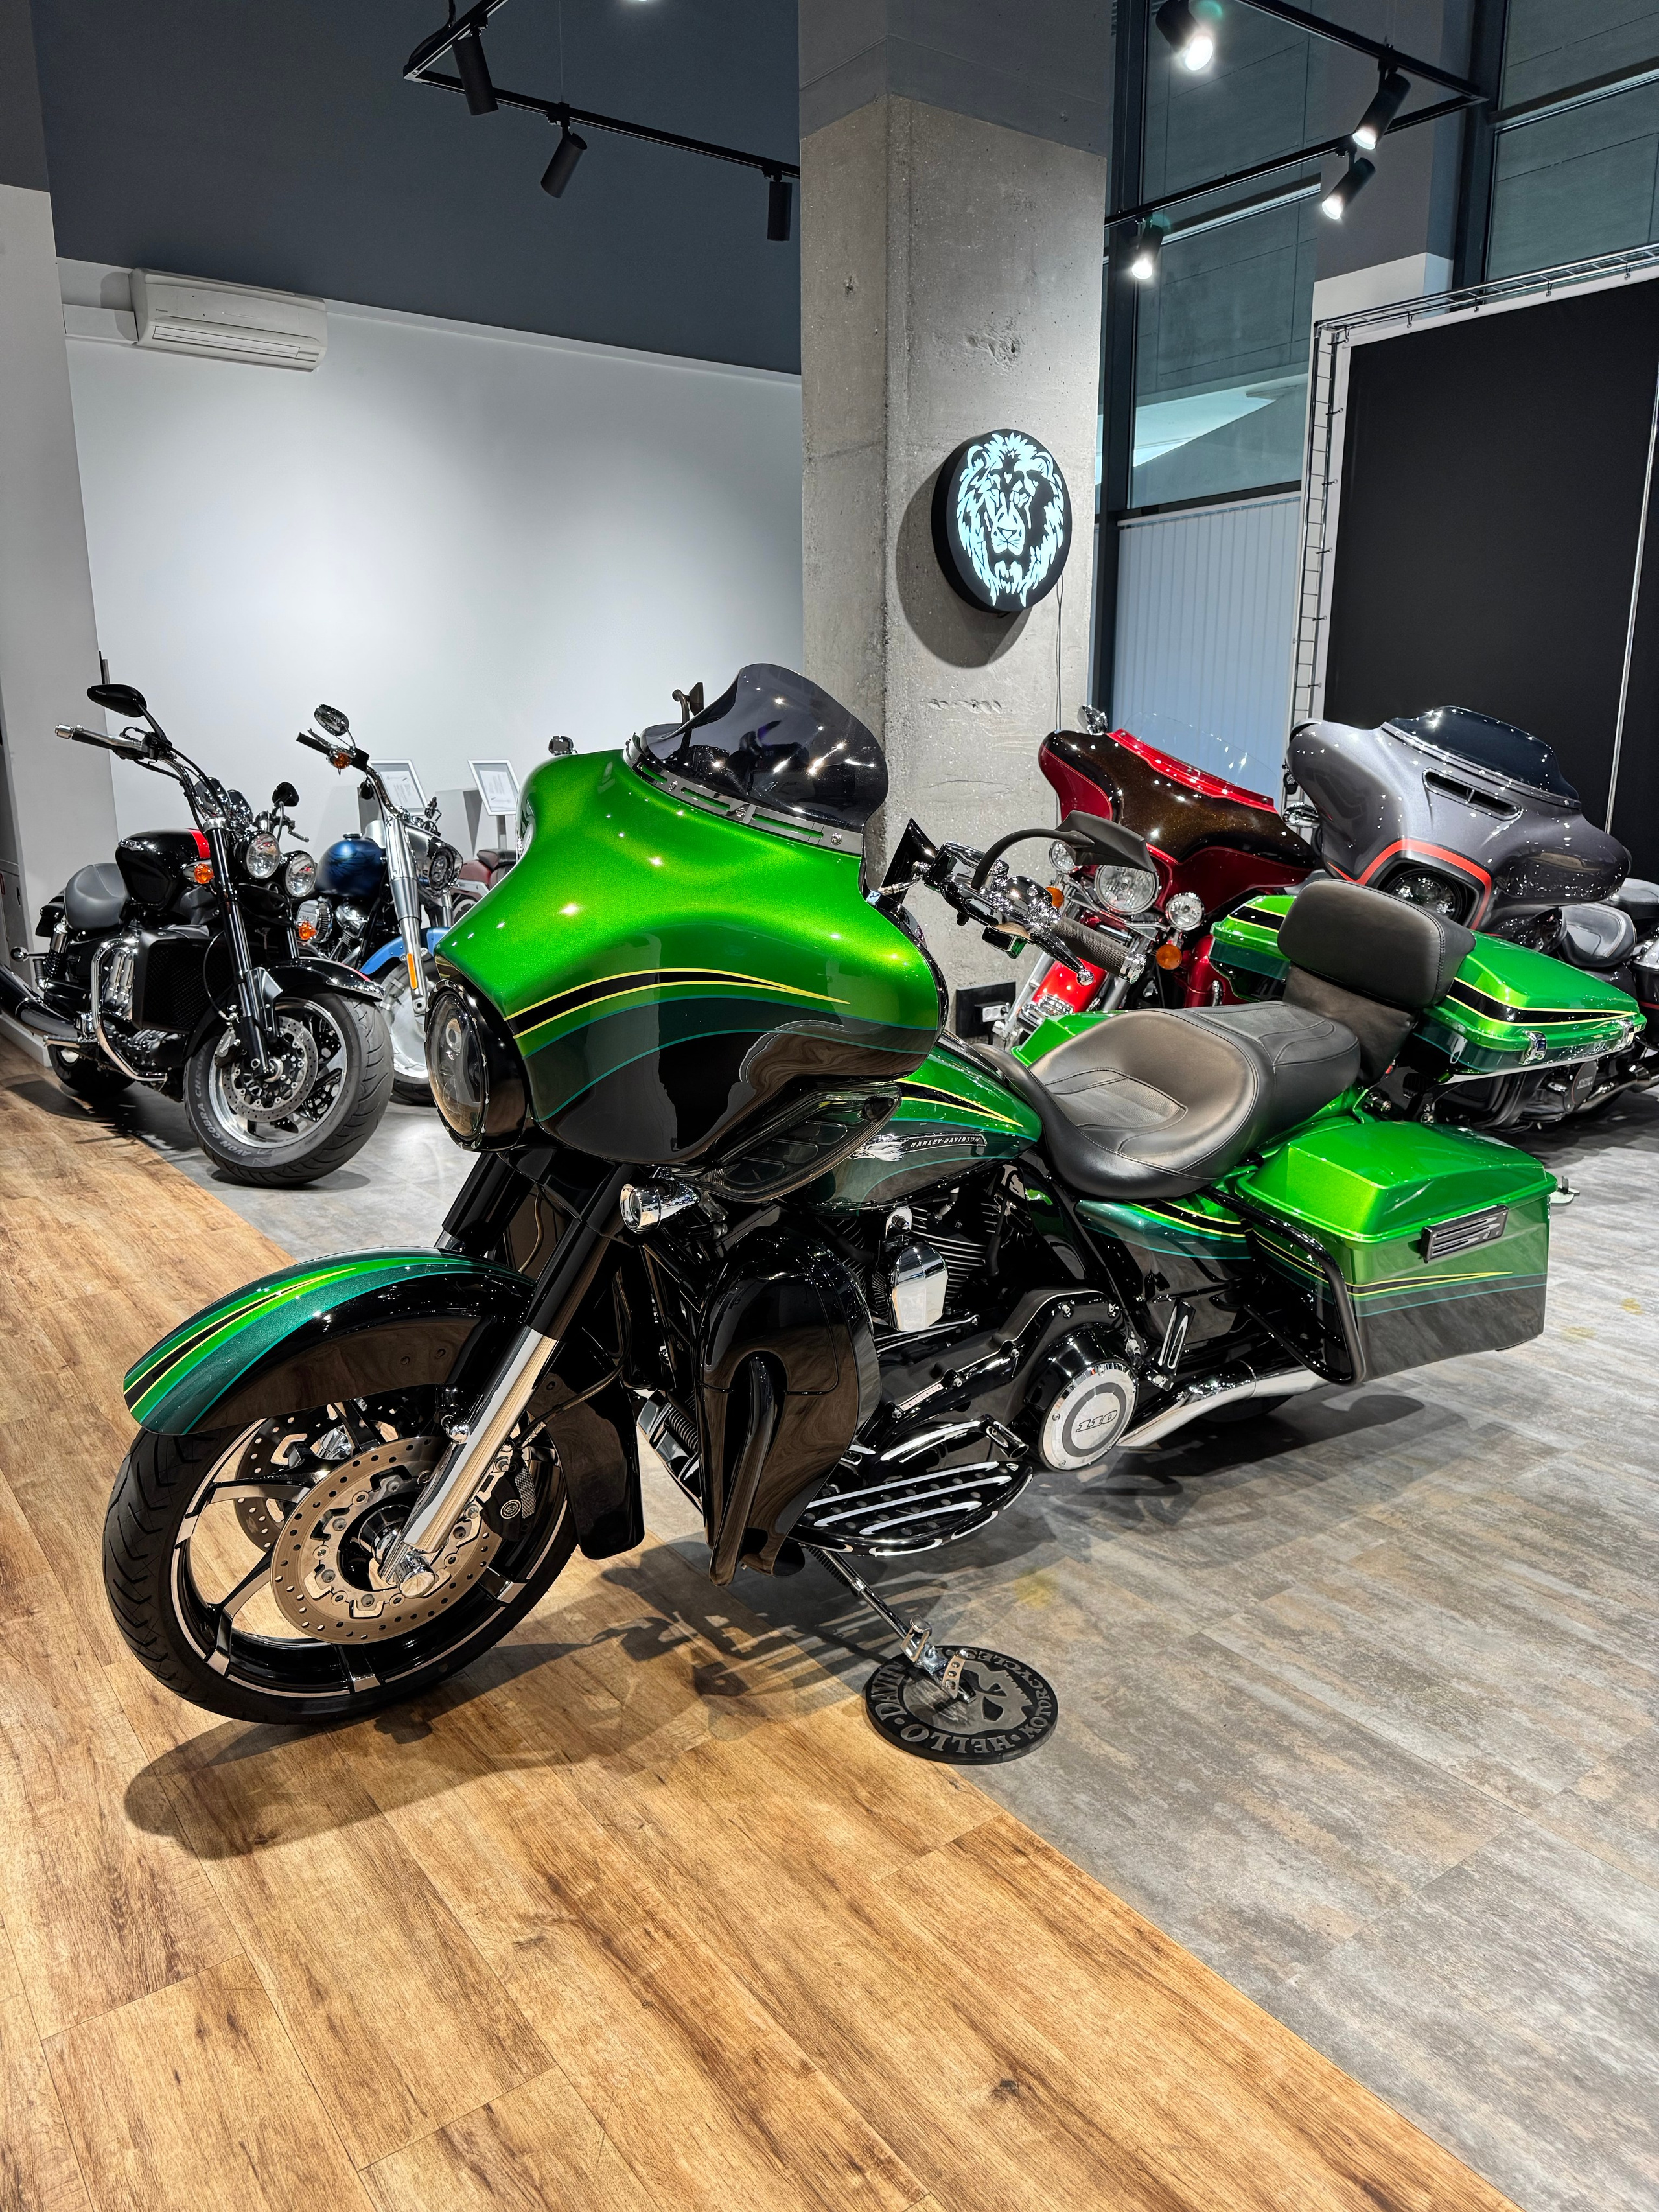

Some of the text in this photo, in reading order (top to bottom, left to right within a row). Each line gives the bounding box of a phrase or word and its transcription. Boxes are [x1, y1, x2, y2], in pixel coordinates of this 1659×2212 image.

[197, 1103, 220, 1139] COBRA
[219, 1139, 252, 1156] AVON
[910, 1137, 980, 1148] HARLEY-DAVIDSON
[1076, 1410, 1118, 1433] 110
[900, 1723, 1015, 1754] HELLO
